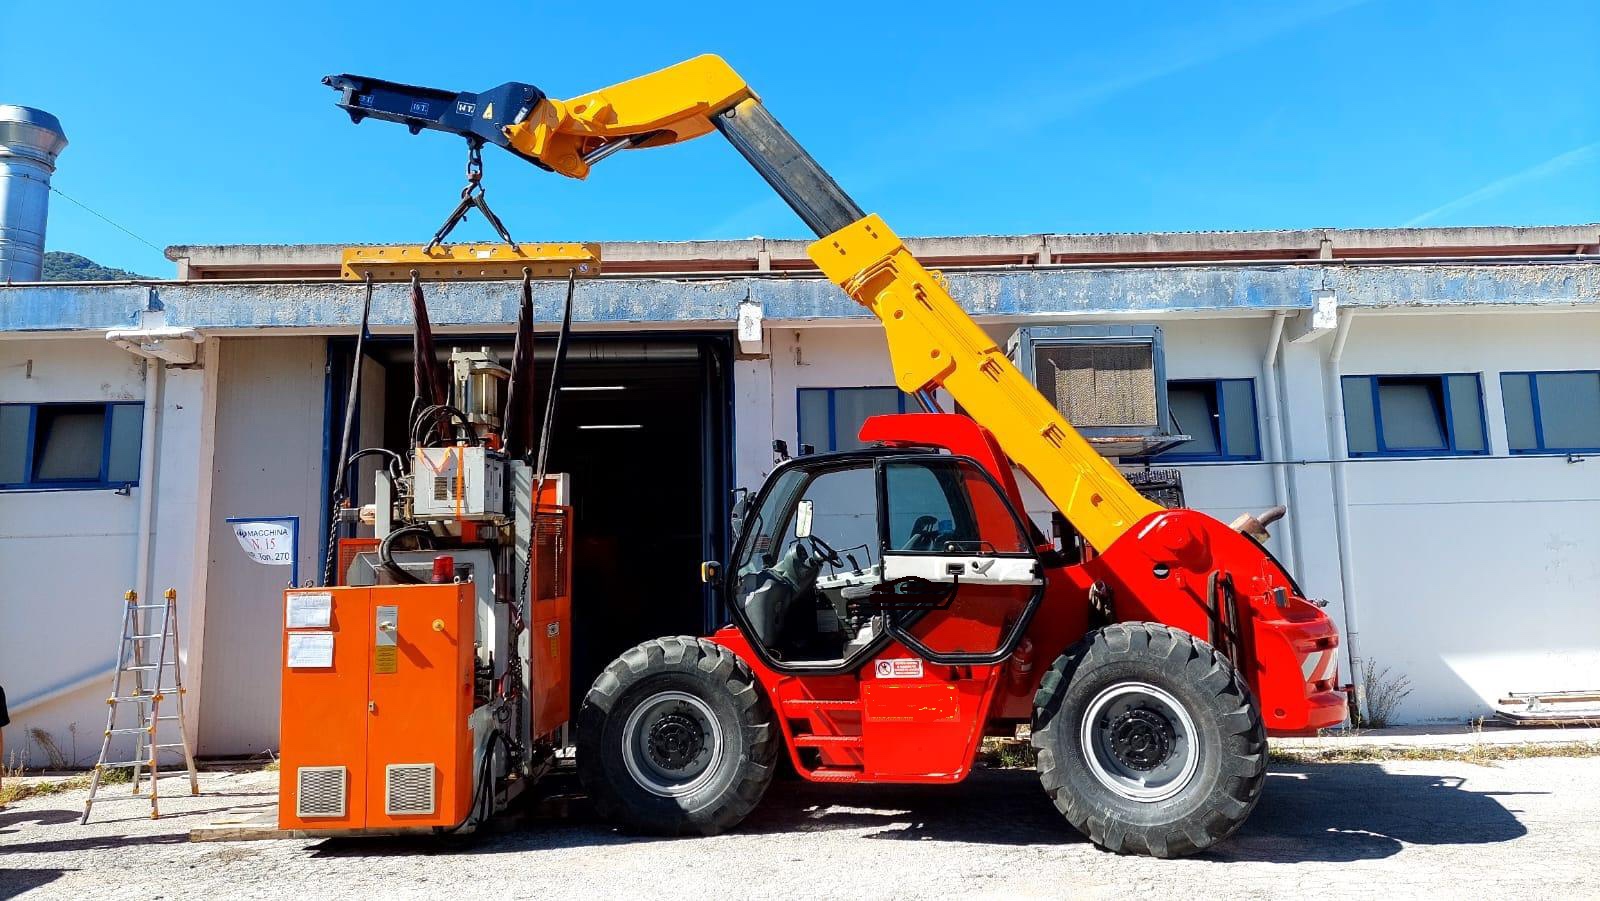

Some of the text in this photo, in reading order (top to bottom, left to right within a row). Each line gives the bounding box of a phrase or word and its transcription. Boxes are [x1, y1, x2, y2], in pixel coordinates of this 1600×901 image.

[247, 529, 288, 537] MACCHINA
[265, 538, 276, 550] 15
[275, 552, 290, 561] 270
